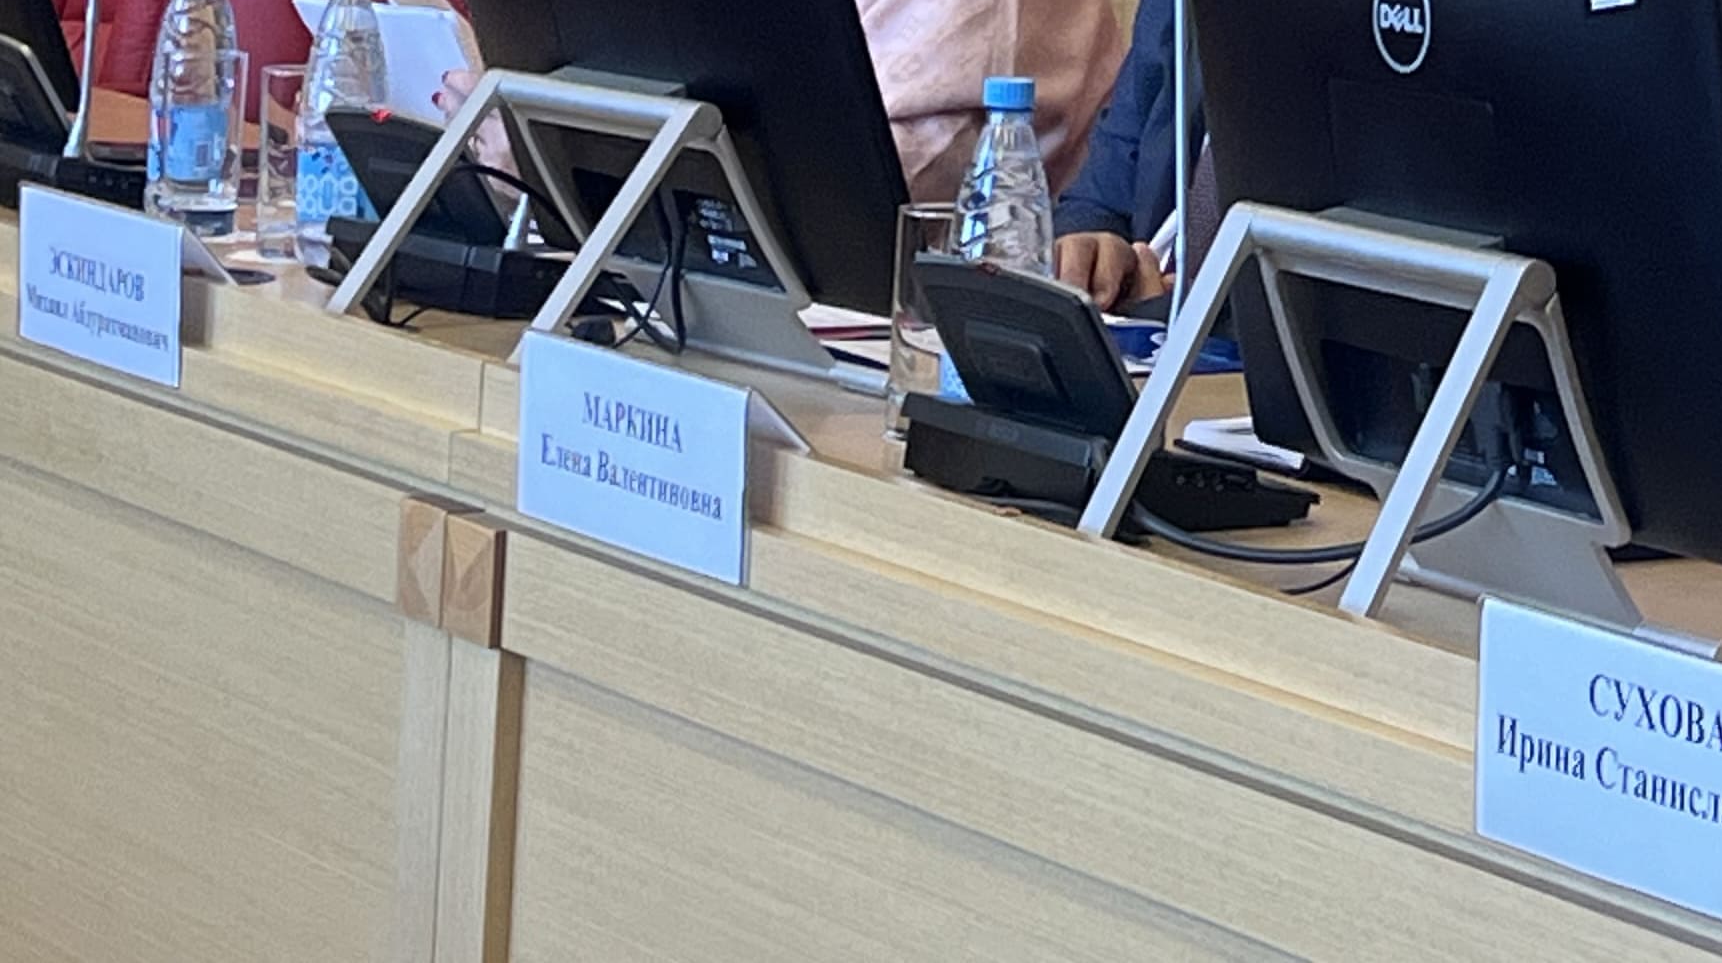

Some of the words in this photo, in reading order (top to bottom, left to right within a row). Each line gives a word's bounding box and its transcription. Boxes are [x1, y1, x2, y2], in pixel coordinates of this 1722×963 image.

[1380, 3, 1424, 34] DELL
[582, 391, 683, 454] МАРКИНА
[540, 432, 592, 478] Елена
[596, 448, 722, 521] Валентиновна
[1497, 713, 1587, 780] Ирина
